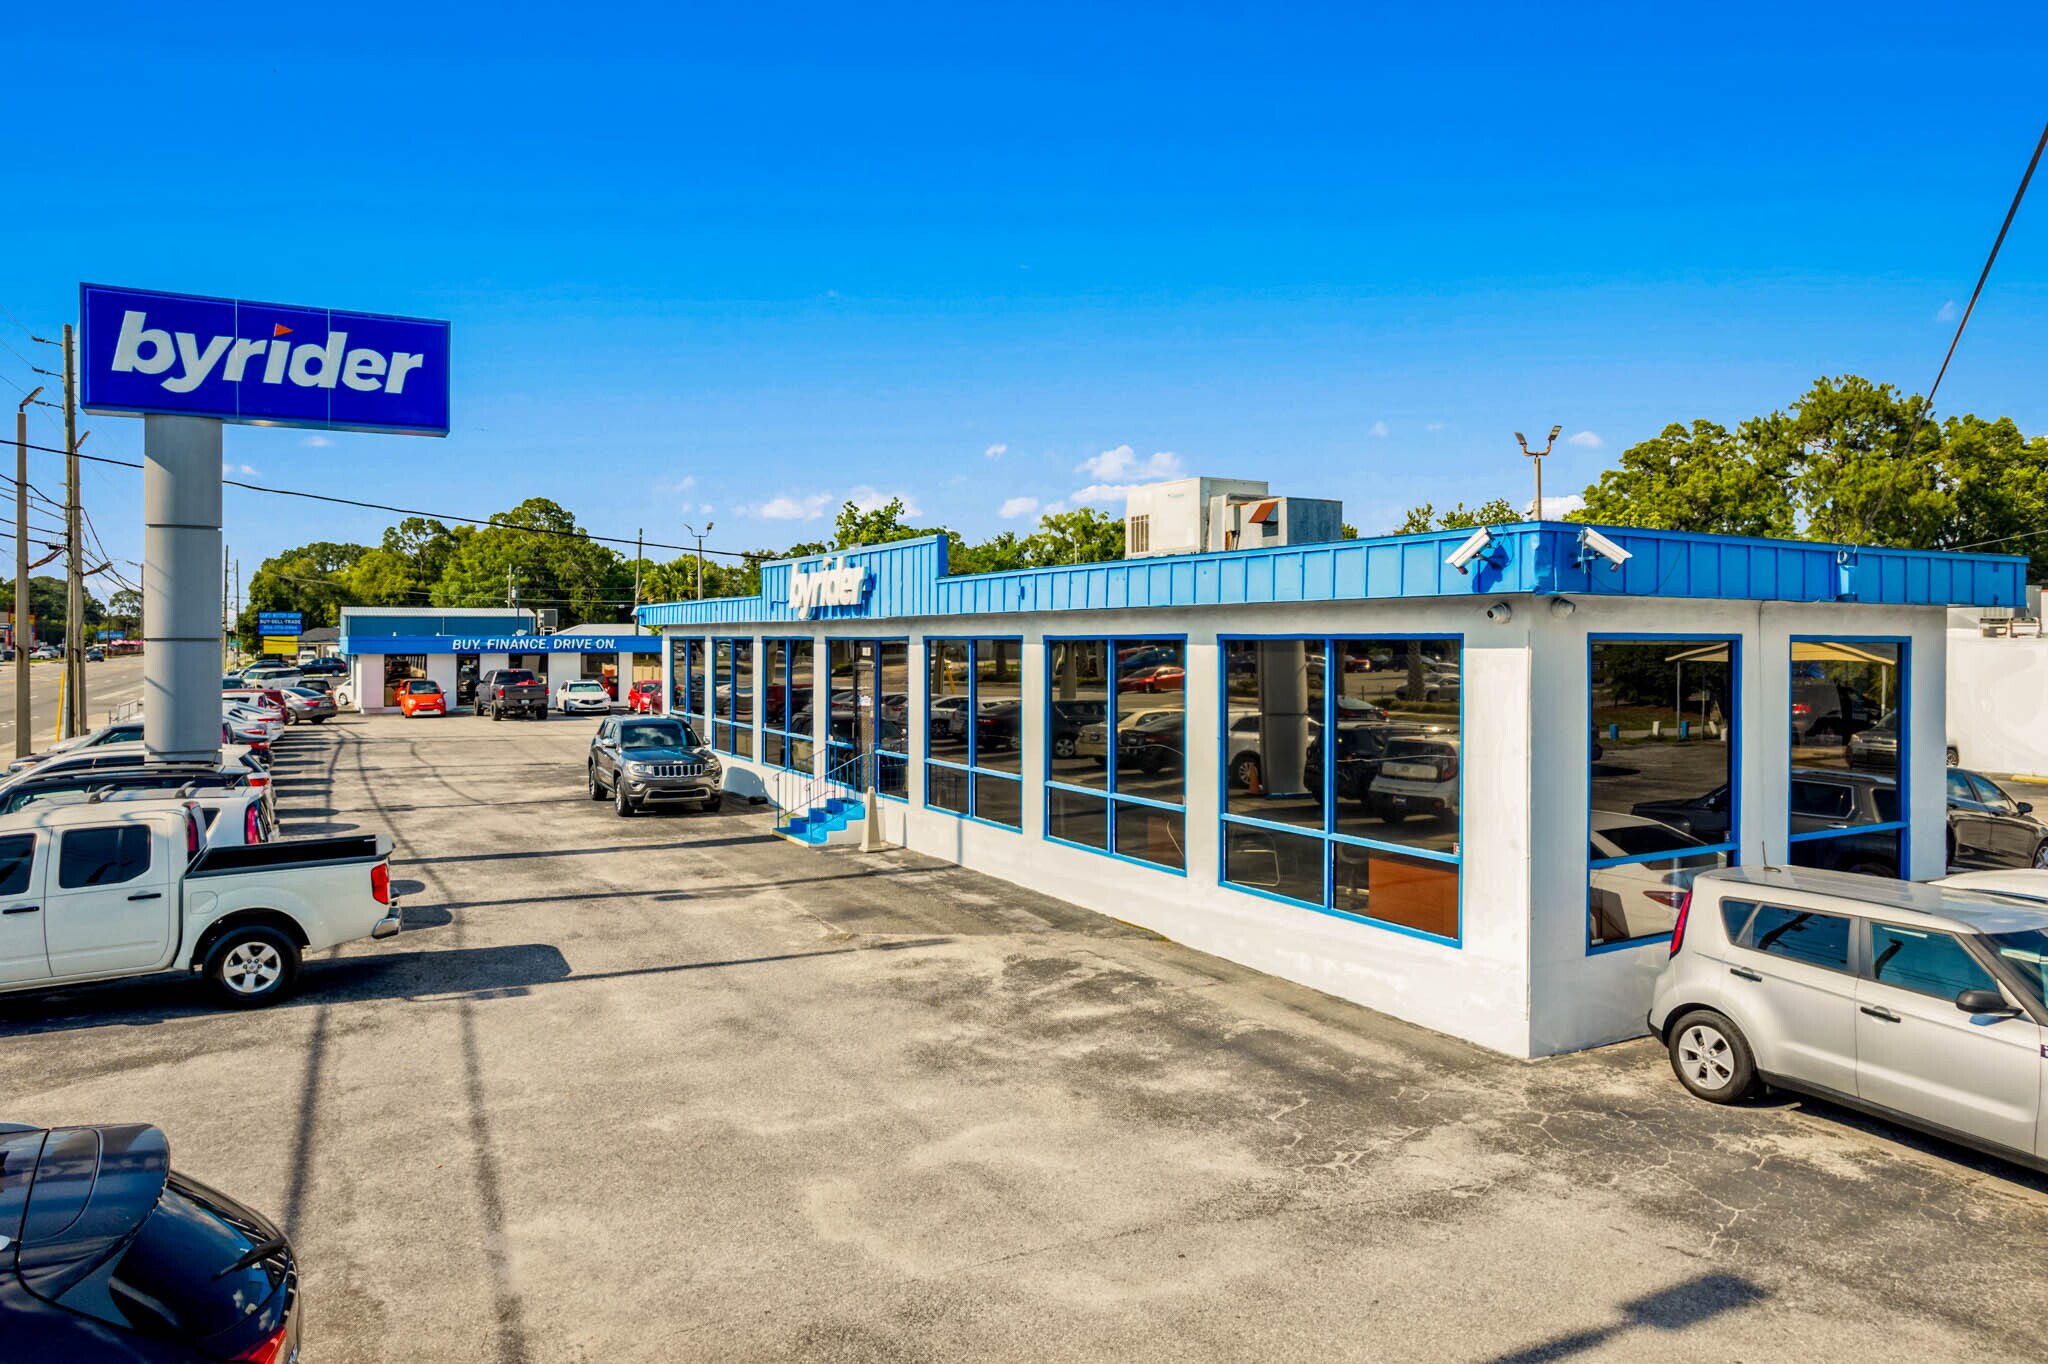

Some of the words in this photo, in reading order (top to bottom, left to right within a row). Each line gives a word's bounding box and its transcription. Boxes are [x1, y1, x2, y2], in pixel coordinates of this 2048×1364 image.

[112, 310, 424, 393] byrider
[789, 556, 864, 619] byrider
[452, 639, 481, 650] BUY.
[487, 638, 549, 650] FINANCE.
[553, 638, 592, 649] DRIVE
[595, 638, 617, 649] ON.
